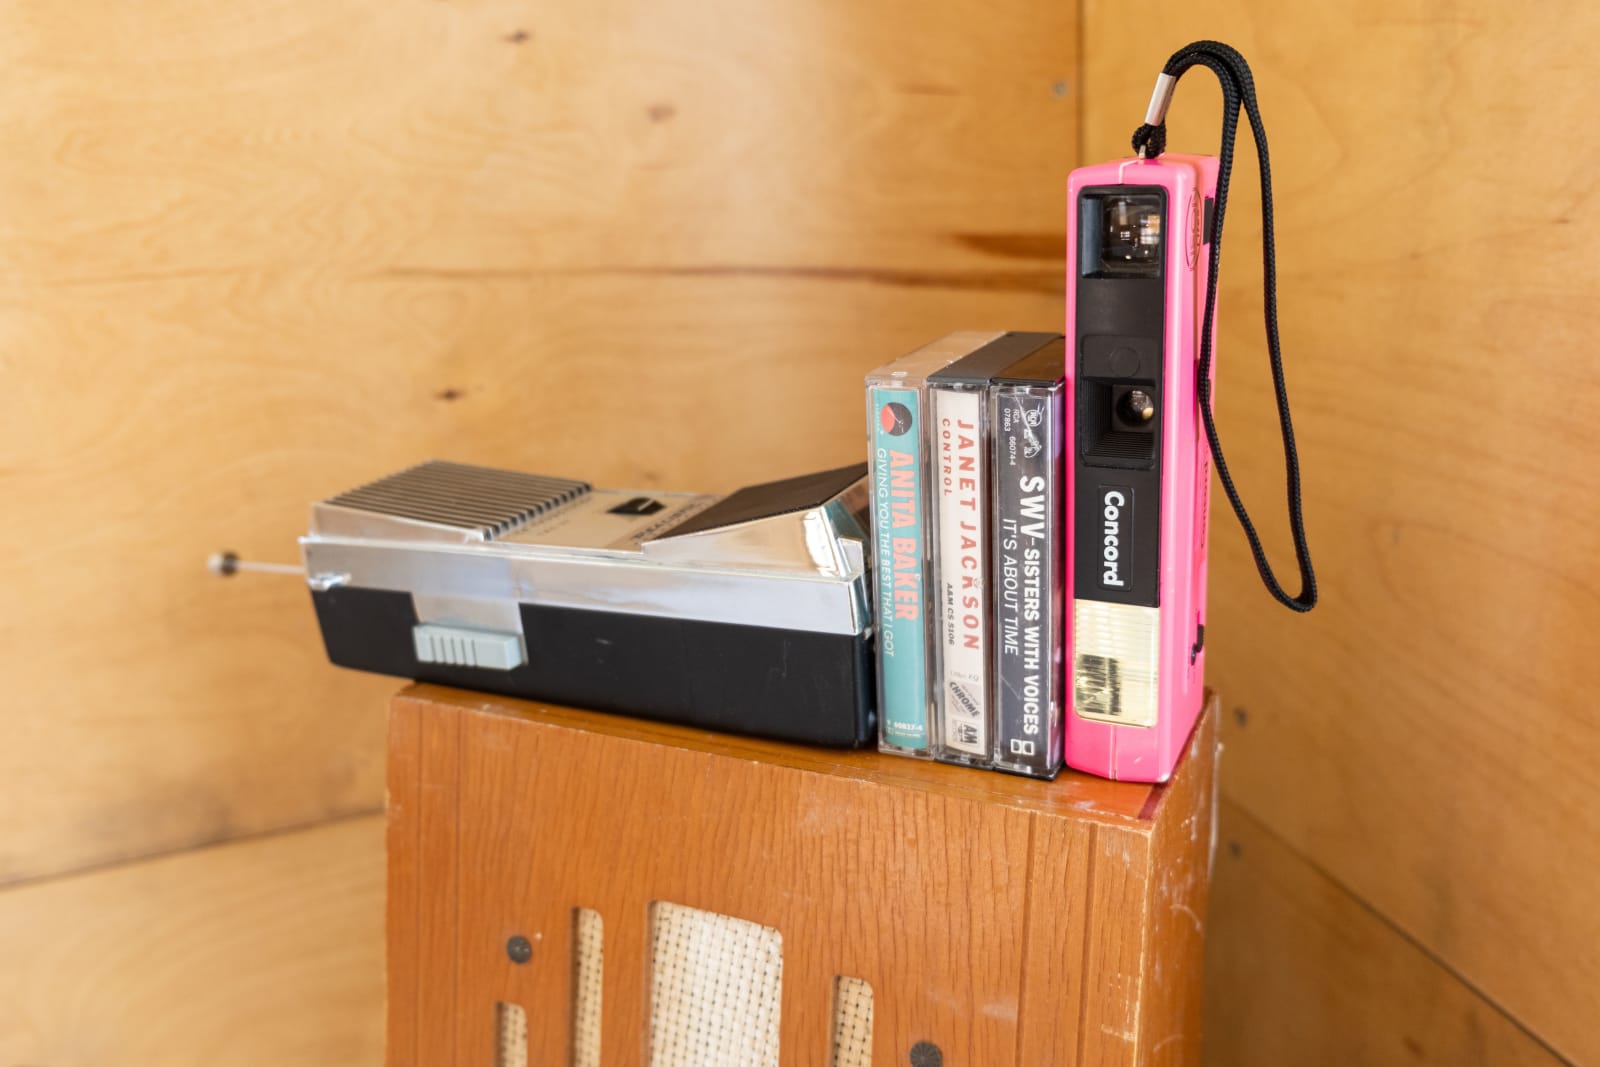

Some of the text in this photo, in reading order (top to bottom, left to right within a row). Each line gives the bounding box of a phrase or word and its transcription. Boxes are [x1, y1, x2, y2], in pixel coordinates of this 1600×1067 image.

[876, 447, 888, 498] GIVING
[942, 418, 952, 496] CONTROL
[879, 502, 889, 529] YOU
[889, 450, 919, 621] ANITA BAKER
[957, 420, 980, 649] JANET JACKSON
[880, 532, 890, 556] THE
[1103, 491, 1125, 586] Concord
[881, 559, 892, 587] BEST
[1002, 518, 1019, 656] IT'S ABOUT TIME
[881, 591, 893, 621] THAT
[948, 607, 954, 620] CS
[883, 630, 894, 657] GOT
[1023, 626, 1040, 670] WITH
[949, 682, 980, 717] CHROME
[1023, 675, 1039, 735] VOICES
